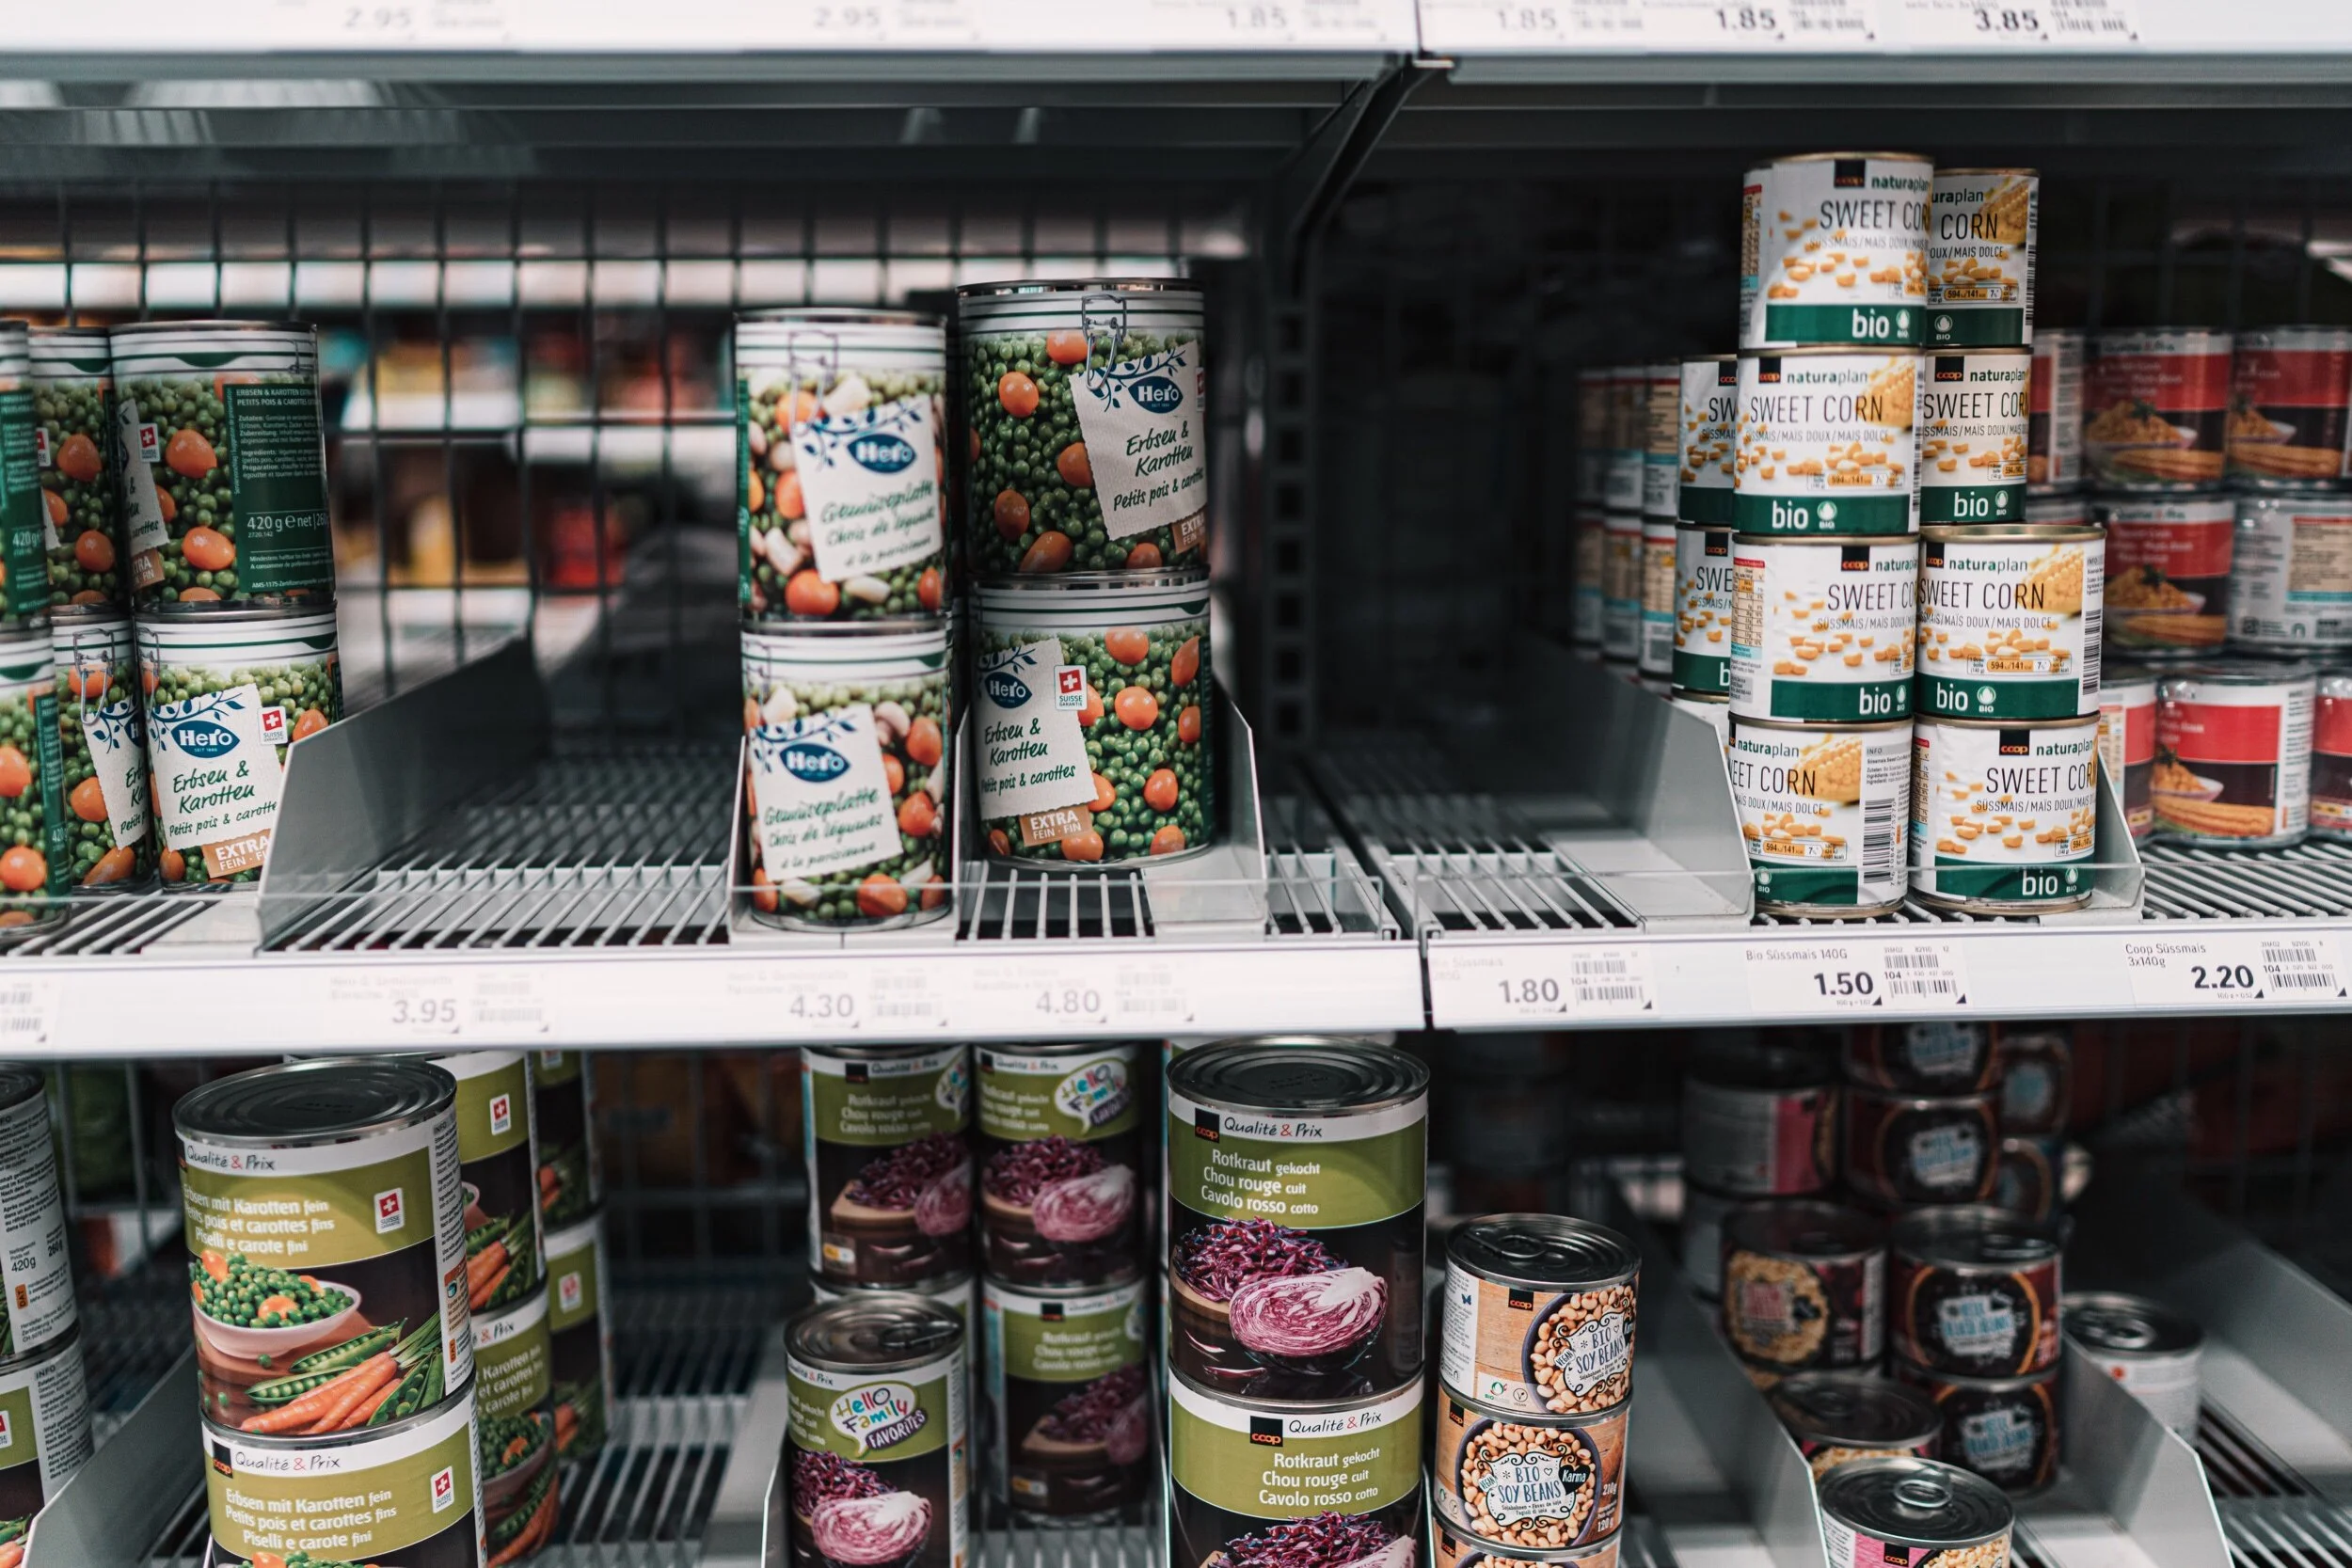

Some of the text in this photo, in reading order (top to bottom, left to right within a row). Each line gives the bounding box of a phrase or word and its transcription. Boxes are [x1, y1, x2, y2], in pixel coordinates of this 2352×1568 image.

[1715, 8, 1776, 29] 1.85
[1975, 9, 2039, 31] 3.85
[1820, 198, 1896, 230] SWEET
[1940, 213, 1997, 240] CORN
[1851, 307, 1889, 339] bio
[1787, 367, 1867, 386] naturaplan
[1935, 371, 1962, 383] coop
[236, 388, 262, 397] ERBSEN
[237, 398, 260, 406] PETITS
[1137, 384, 1178, 402] Hero
[1750, 394, 1883, 423] SWEET CORN
[1923, 391, 1994, 419] SWEET
[855, 442, 913, 463] Hero
[1126, 427, 1176, 456] Erbsen
[1135, 443, 1193, 477] Karotten
[1113, 481, 1169, 511] Petits pois
[1953, 492, 1988, 517] bio
[246, 515, 272, 529] 420
[1771, 499, 1808, 530] bio
[1842, 560, 1867, 571] coop
[1948, 557, 2027, 574] naturaplan
[1827, 583, 1897, 610] SWEET
[1919, 578, 2044, 609] SWEET CORN
[1966, 615, 2051, 628] DOUX/MAIS DOLCE
[989, 680, 1025, 698] Hero
[1058, 694, 1082, 704] SUISSE
[1936, 682, 1968, 711] bio
[1859, 687, 1891, 714] bio
[1979, 705, 1994, 713] BIO
[178, 726, 232, 746] Hero
[984, 721, 1023, 745] Erbsen
[989, 740, 1047, 766] Karotten
[1737, 739, 1799, 757] naturaplan
[2000, 739, 2092, 756] coop naturaplan
[786, 751, 845, 771] Hero
[172, 765, 227, 794] Erbsen
[1030, 764, 1075, 785] carottes
[1760, 765, 1815, 796] CORN
[1985, 767, 2060, 794] SWEET
[178, 783, 255, 814] Karotten
[1795, 802, 1823, 815] DOLCE
[169, 816, 218, 836] Petits pois
[1030, 809, 1078, 831] EXTRA
[1766, 843, 1778, 853] 594
[1757, 885, 1771, 895] BIO
[2022, 870, 2058, 895] bio
[1745, 948, 1847, 961] Bio Süssmais 140G
[2124, 942, 2205, 955] Coop Süssmais
[2127, 956, 2166, 968] 3x140g
[2263, 964, 2281, 974] 104
[1570, 976, 1589, 986] 104
[1813, 971, 1874, 996] 1.50
[1883, 971, 1901, 980] 104
[2190, 964, 2254, 989] 2.20
[1035, 989, 1101, 1013] 4.80
[1498, 977, 1559, 1004] 1.80
[391, 998, 456, 1023] 3.95
[788, 993, 854, 1018] 4.30
[1224, 1116, 1322, 1137] Qualité Prix
[186, 1145, 275, 1170] Qualité Prix
[1212, 1148, 1320, 1177] Rotkraut gekocht
[1203, 1166, 1307, 1196] Chou rouge cuit
[233, 1197, 328, 1217] Karotten fein
[1200, 1184, 1319, 1214] Cavolo rosso cotto
[204, 1214, 334, 1234] pois carottes fins
[195, 1226, 309, 1256] Piselli carote fini
[11, 1256, 36, 1272] 420g
[1509, 1299, 1533, 1310] coop
[1591, 1326, 1612, 1349] BIO
[1555, 1349, 1574, 1366] VEGAN
[1575, 1335, 1624, 1373] SOY BEANS
[36, 1364, 56, 1378] INFO
[841, 1399, 908, 1433] Family
[1250, 1412, 1383, 1445] coop Qualité Prix
[234, 1450, 341, 1470] Qualité Prix
[1273, 1447, 1380, 1468] Rotkraut gekocht
[1262, 1468, 1370, 1490] Chou rouge cuit
[1515, 1465, 1540, 1482] BIO
[1562, 1469, 1586, 1482] Karma
[225, 1488, 391, 1513] Erbsen mit Karotten fein
[1258, 1485, 1378, 1506] Cavolo rosso cotto
[1497, 1480, 1562, 1503] SOY BEANS
[225, 1504, 398, 1532] Petits pois et carottes fins
[242, 1528, 373, 1550] Piselli carote fini
